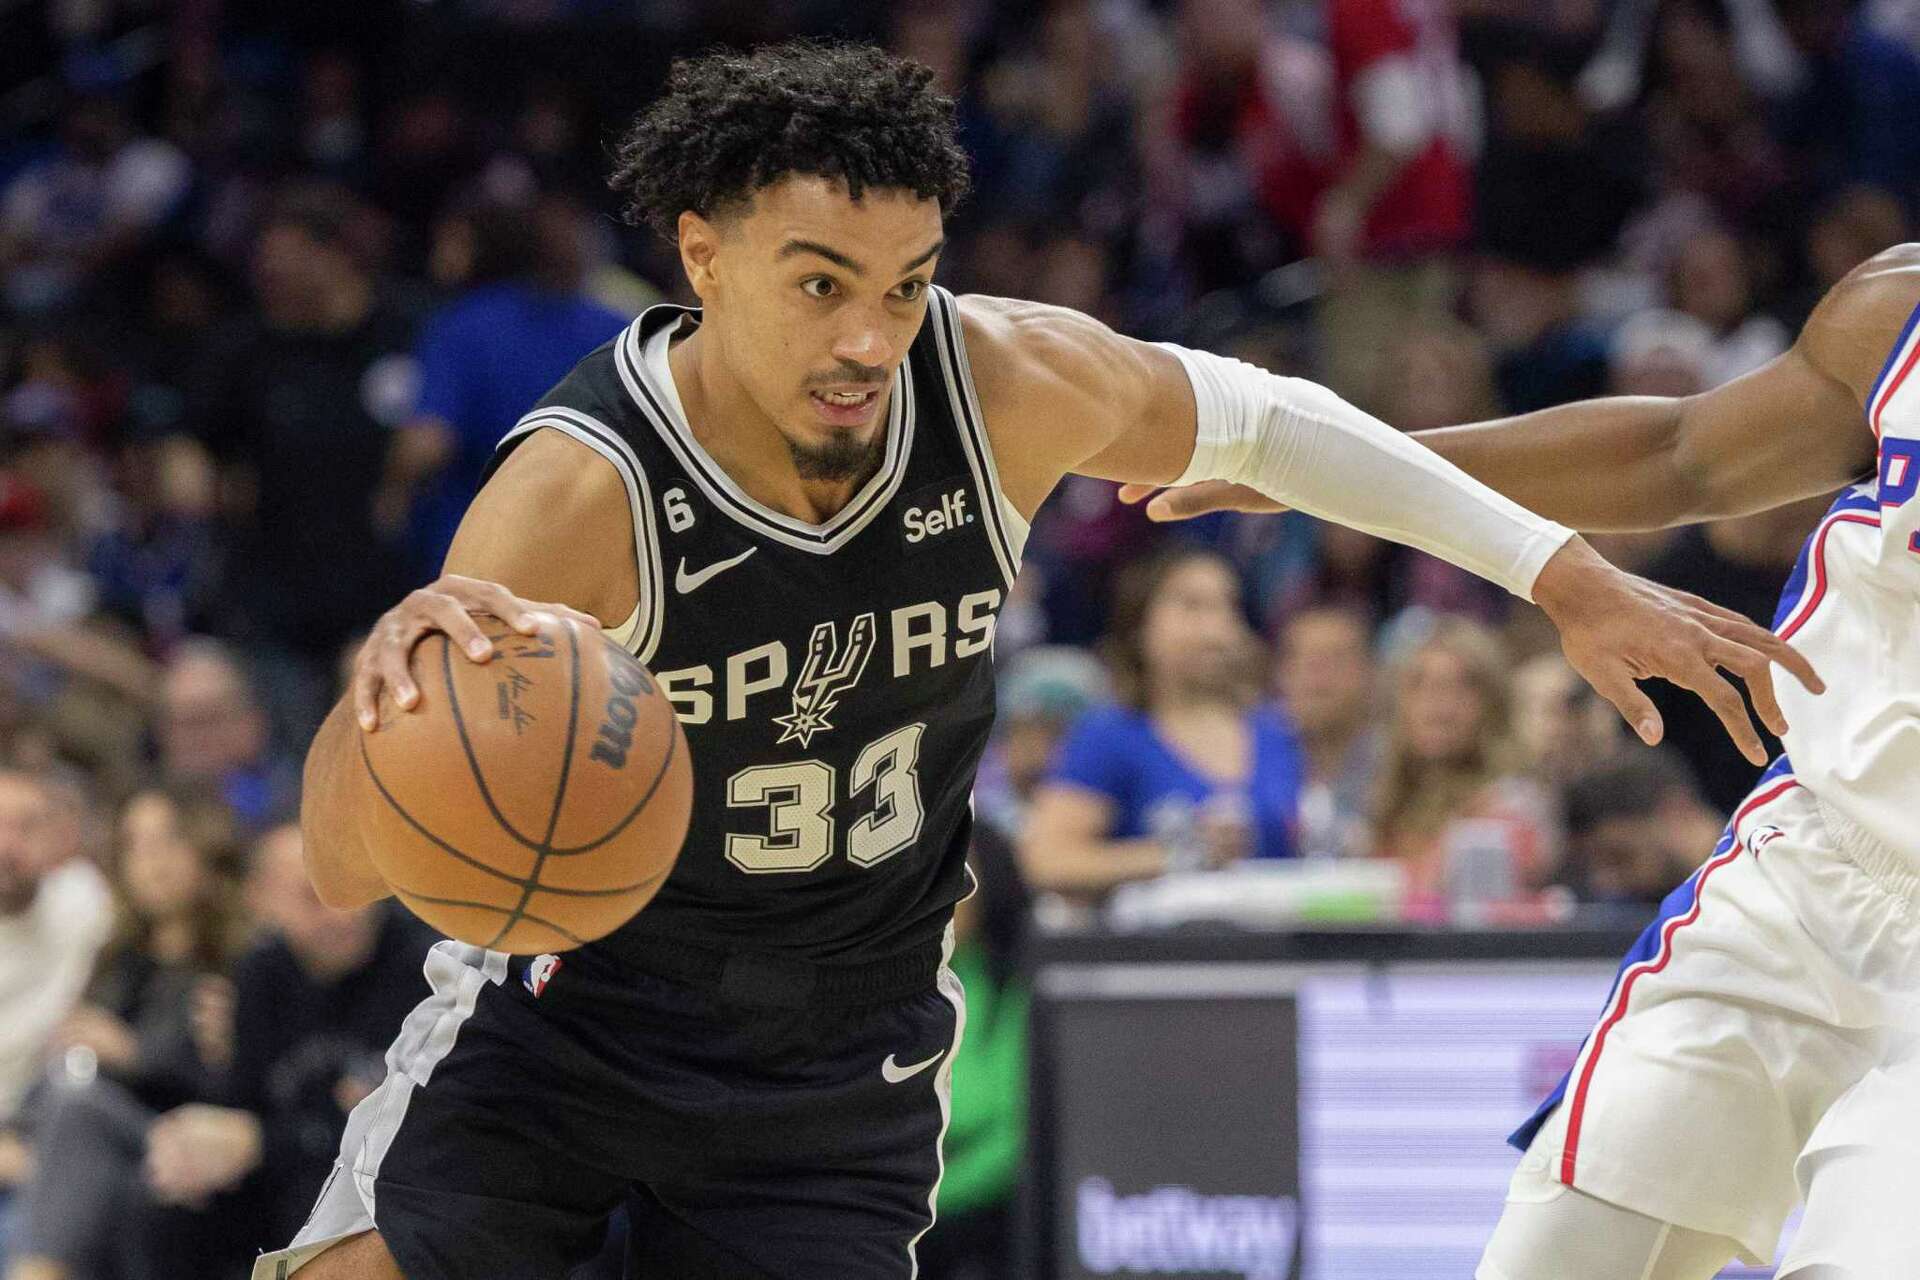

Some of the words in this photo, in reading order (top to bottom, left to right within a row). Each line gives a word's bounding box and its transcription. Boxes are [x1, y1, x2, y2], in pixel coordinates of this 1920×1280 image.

[663, 488, 695, 533] 6
[656, 588, 1001, 748] SPURS
[724, 722, 928, 875] 33
